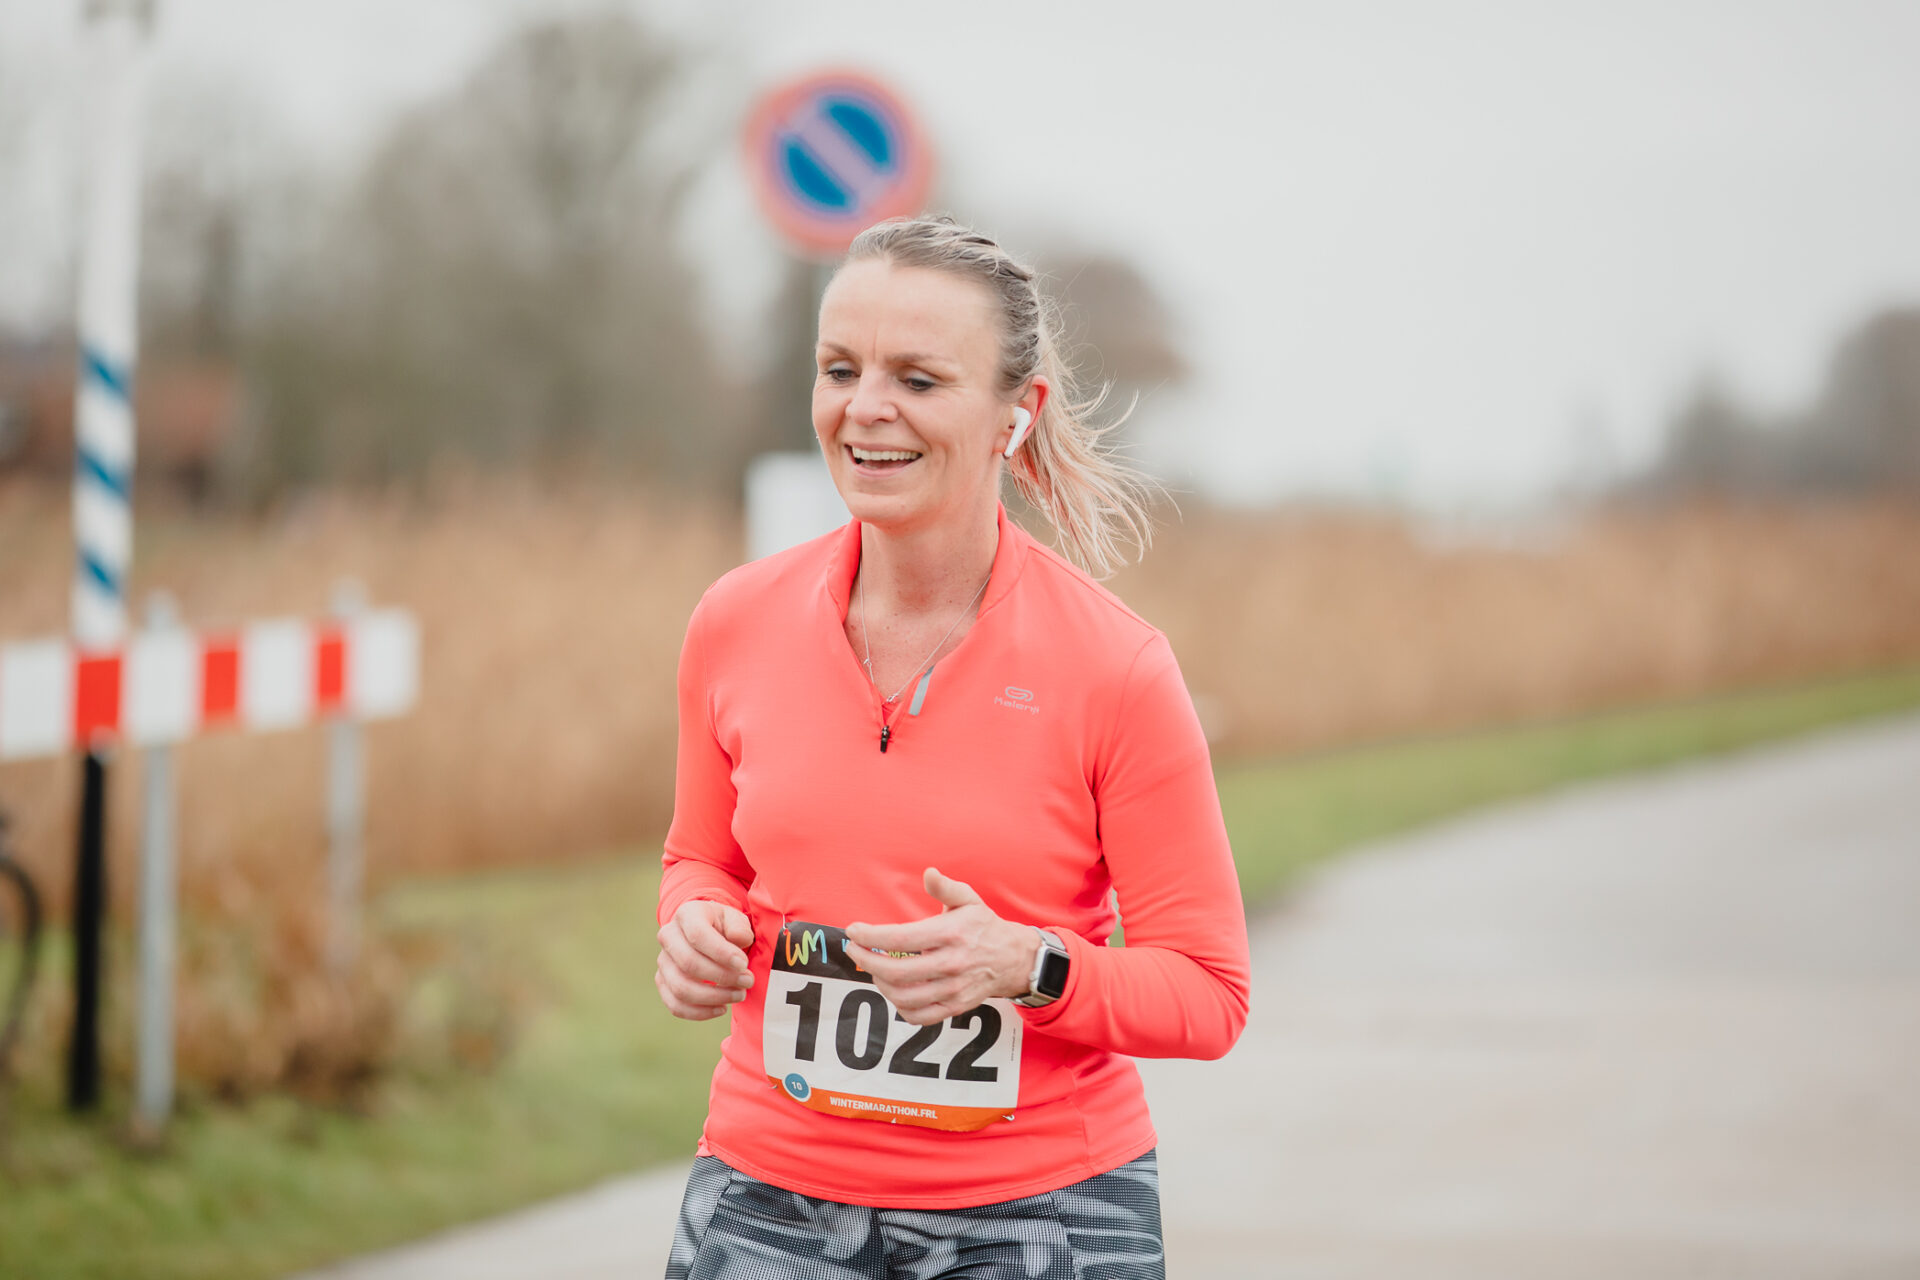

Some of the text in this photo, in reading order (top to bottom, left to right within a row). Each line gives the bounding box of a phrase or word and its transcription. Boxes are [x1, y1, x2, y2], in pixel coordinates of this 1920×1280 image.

[785, 981, 1002, 1083] 1022
[791, 1081, 804, 1092] 10
[829, 1096, 938, 1119] WINTERMARATHON.FRL
